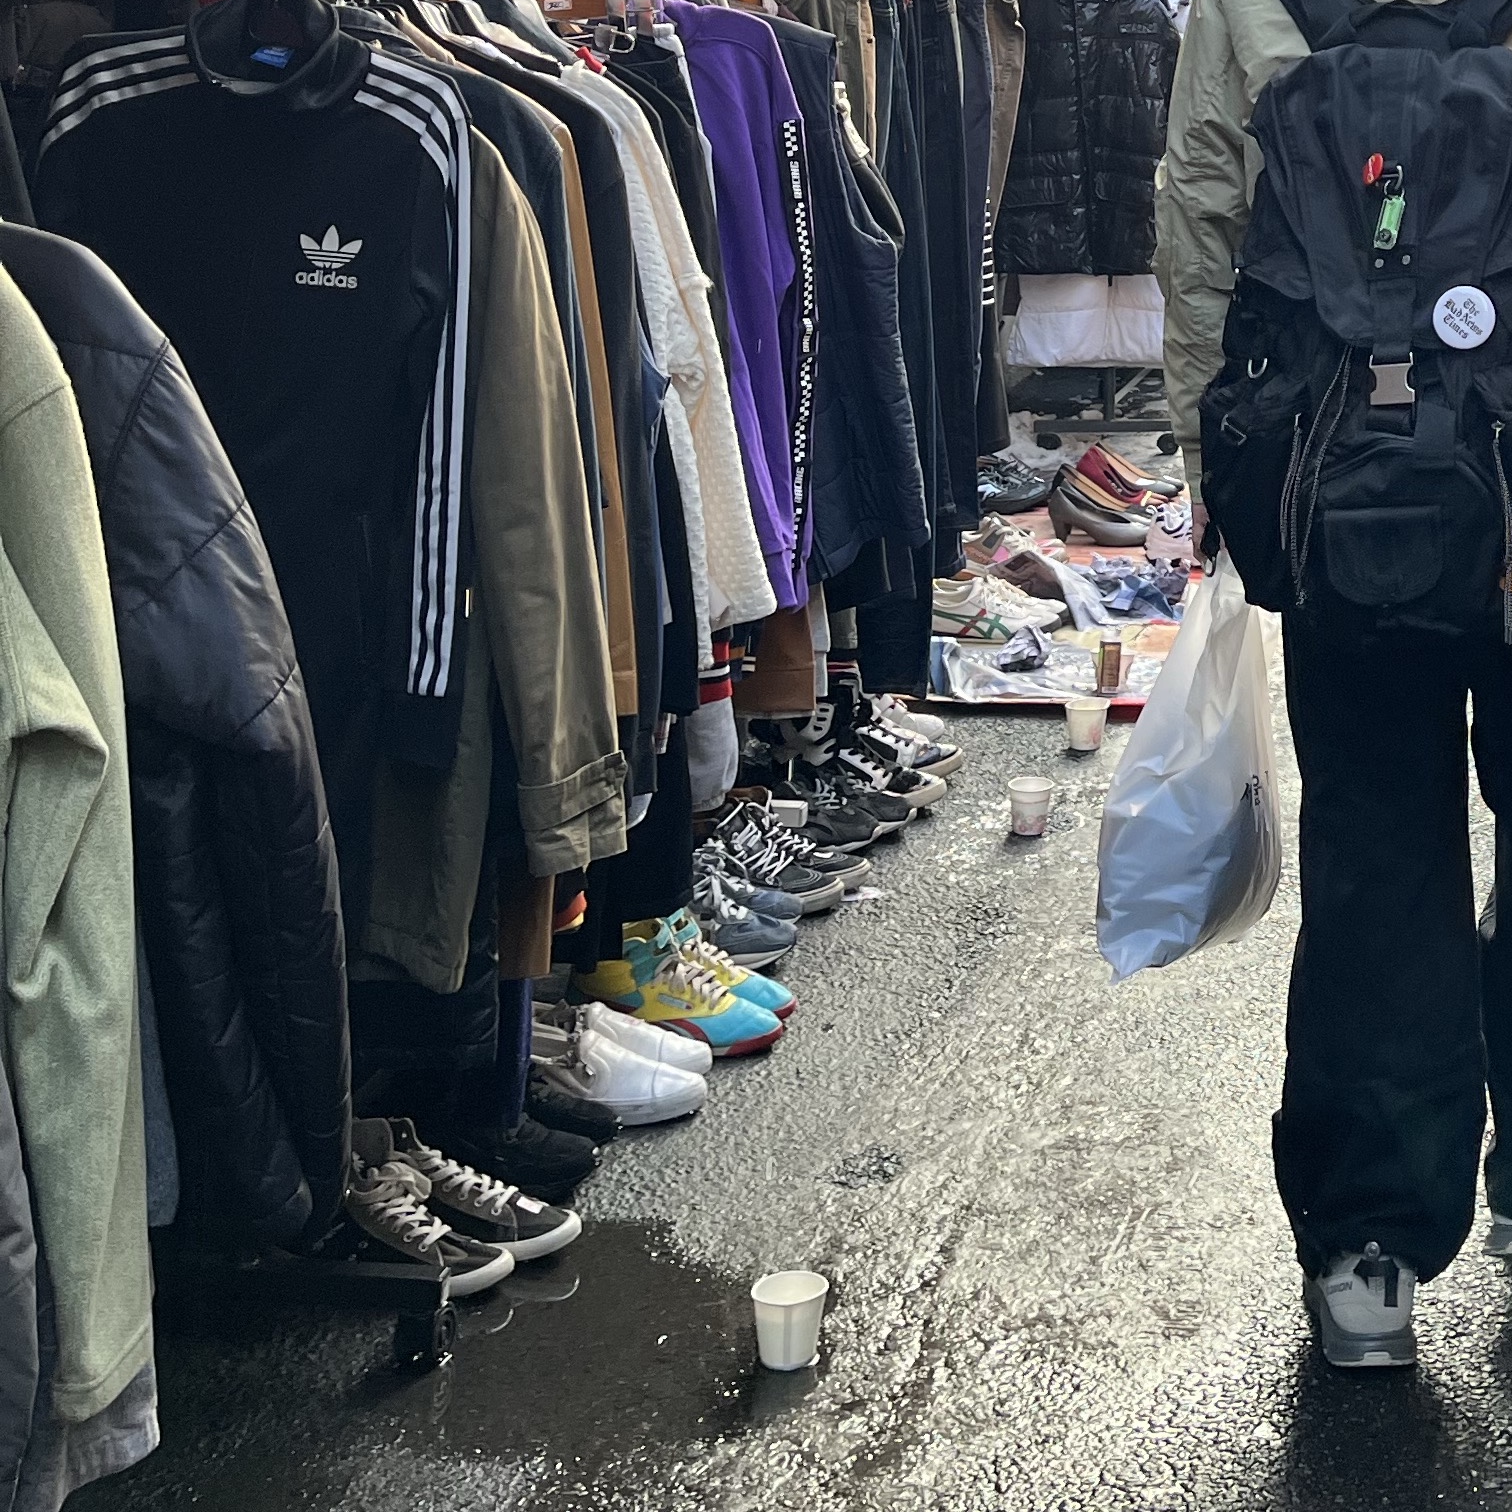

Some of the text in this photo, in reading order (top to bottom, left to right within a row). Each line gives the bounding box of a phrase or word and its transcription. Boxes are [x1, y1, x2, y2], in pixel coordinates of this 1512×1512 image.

[295, 269, 358, 289] adidas
[1463, 298, 1480, 317] The
[1443, 313, 1470, 339] Times
